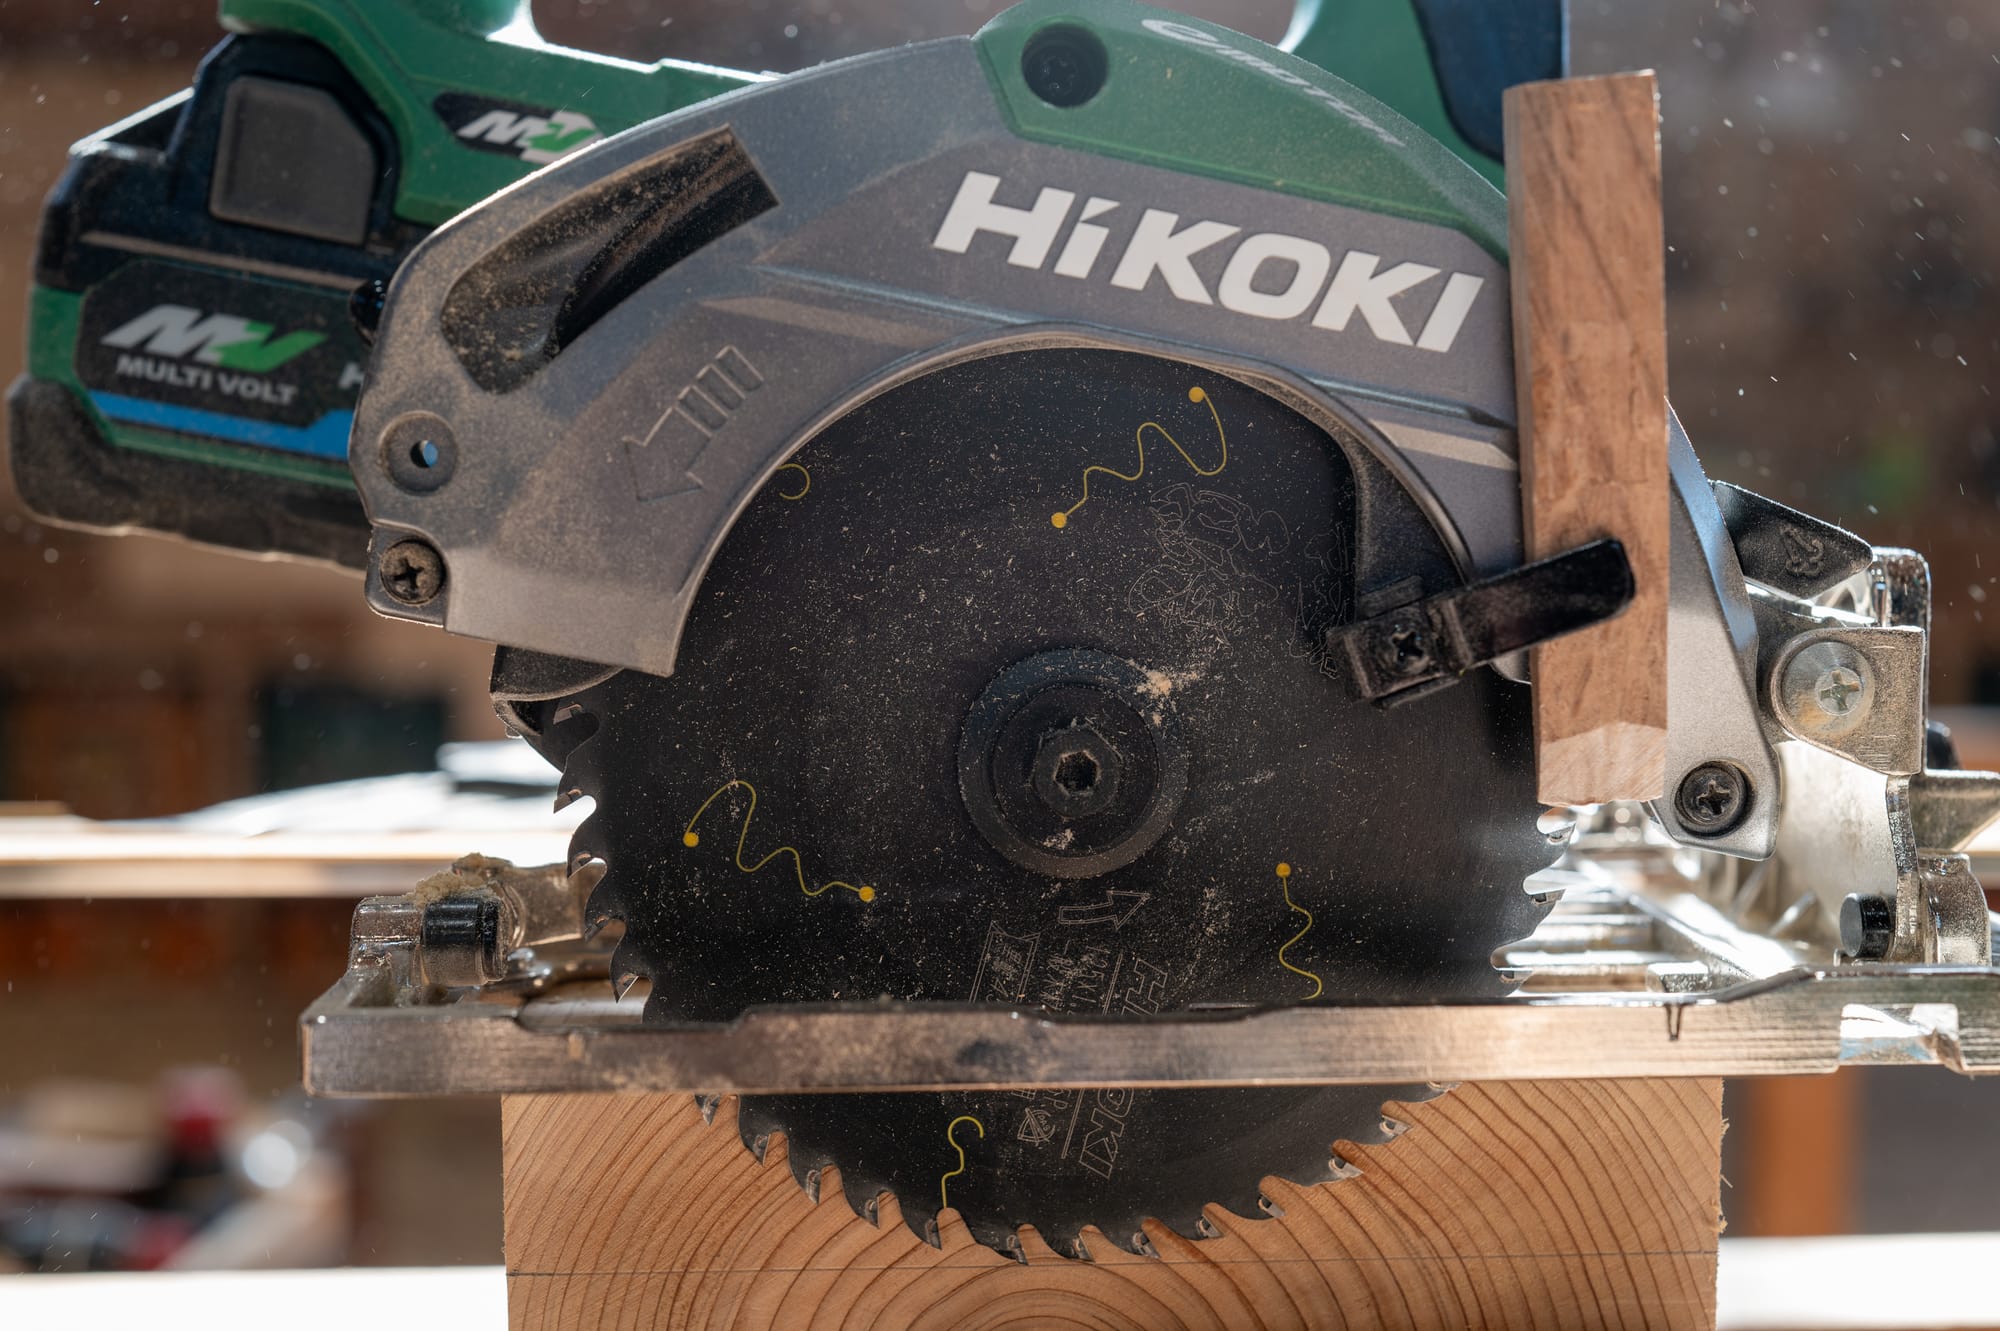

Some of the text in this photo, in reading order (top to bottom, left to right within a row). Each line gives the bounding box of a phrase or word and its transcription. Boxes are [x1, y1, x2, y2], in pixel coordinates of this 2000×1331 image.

[933, 170, 1485, 354] HiKOKI
[115, 345, 213, 390] MULTI
[216, 372, 298, 405] VOLT
